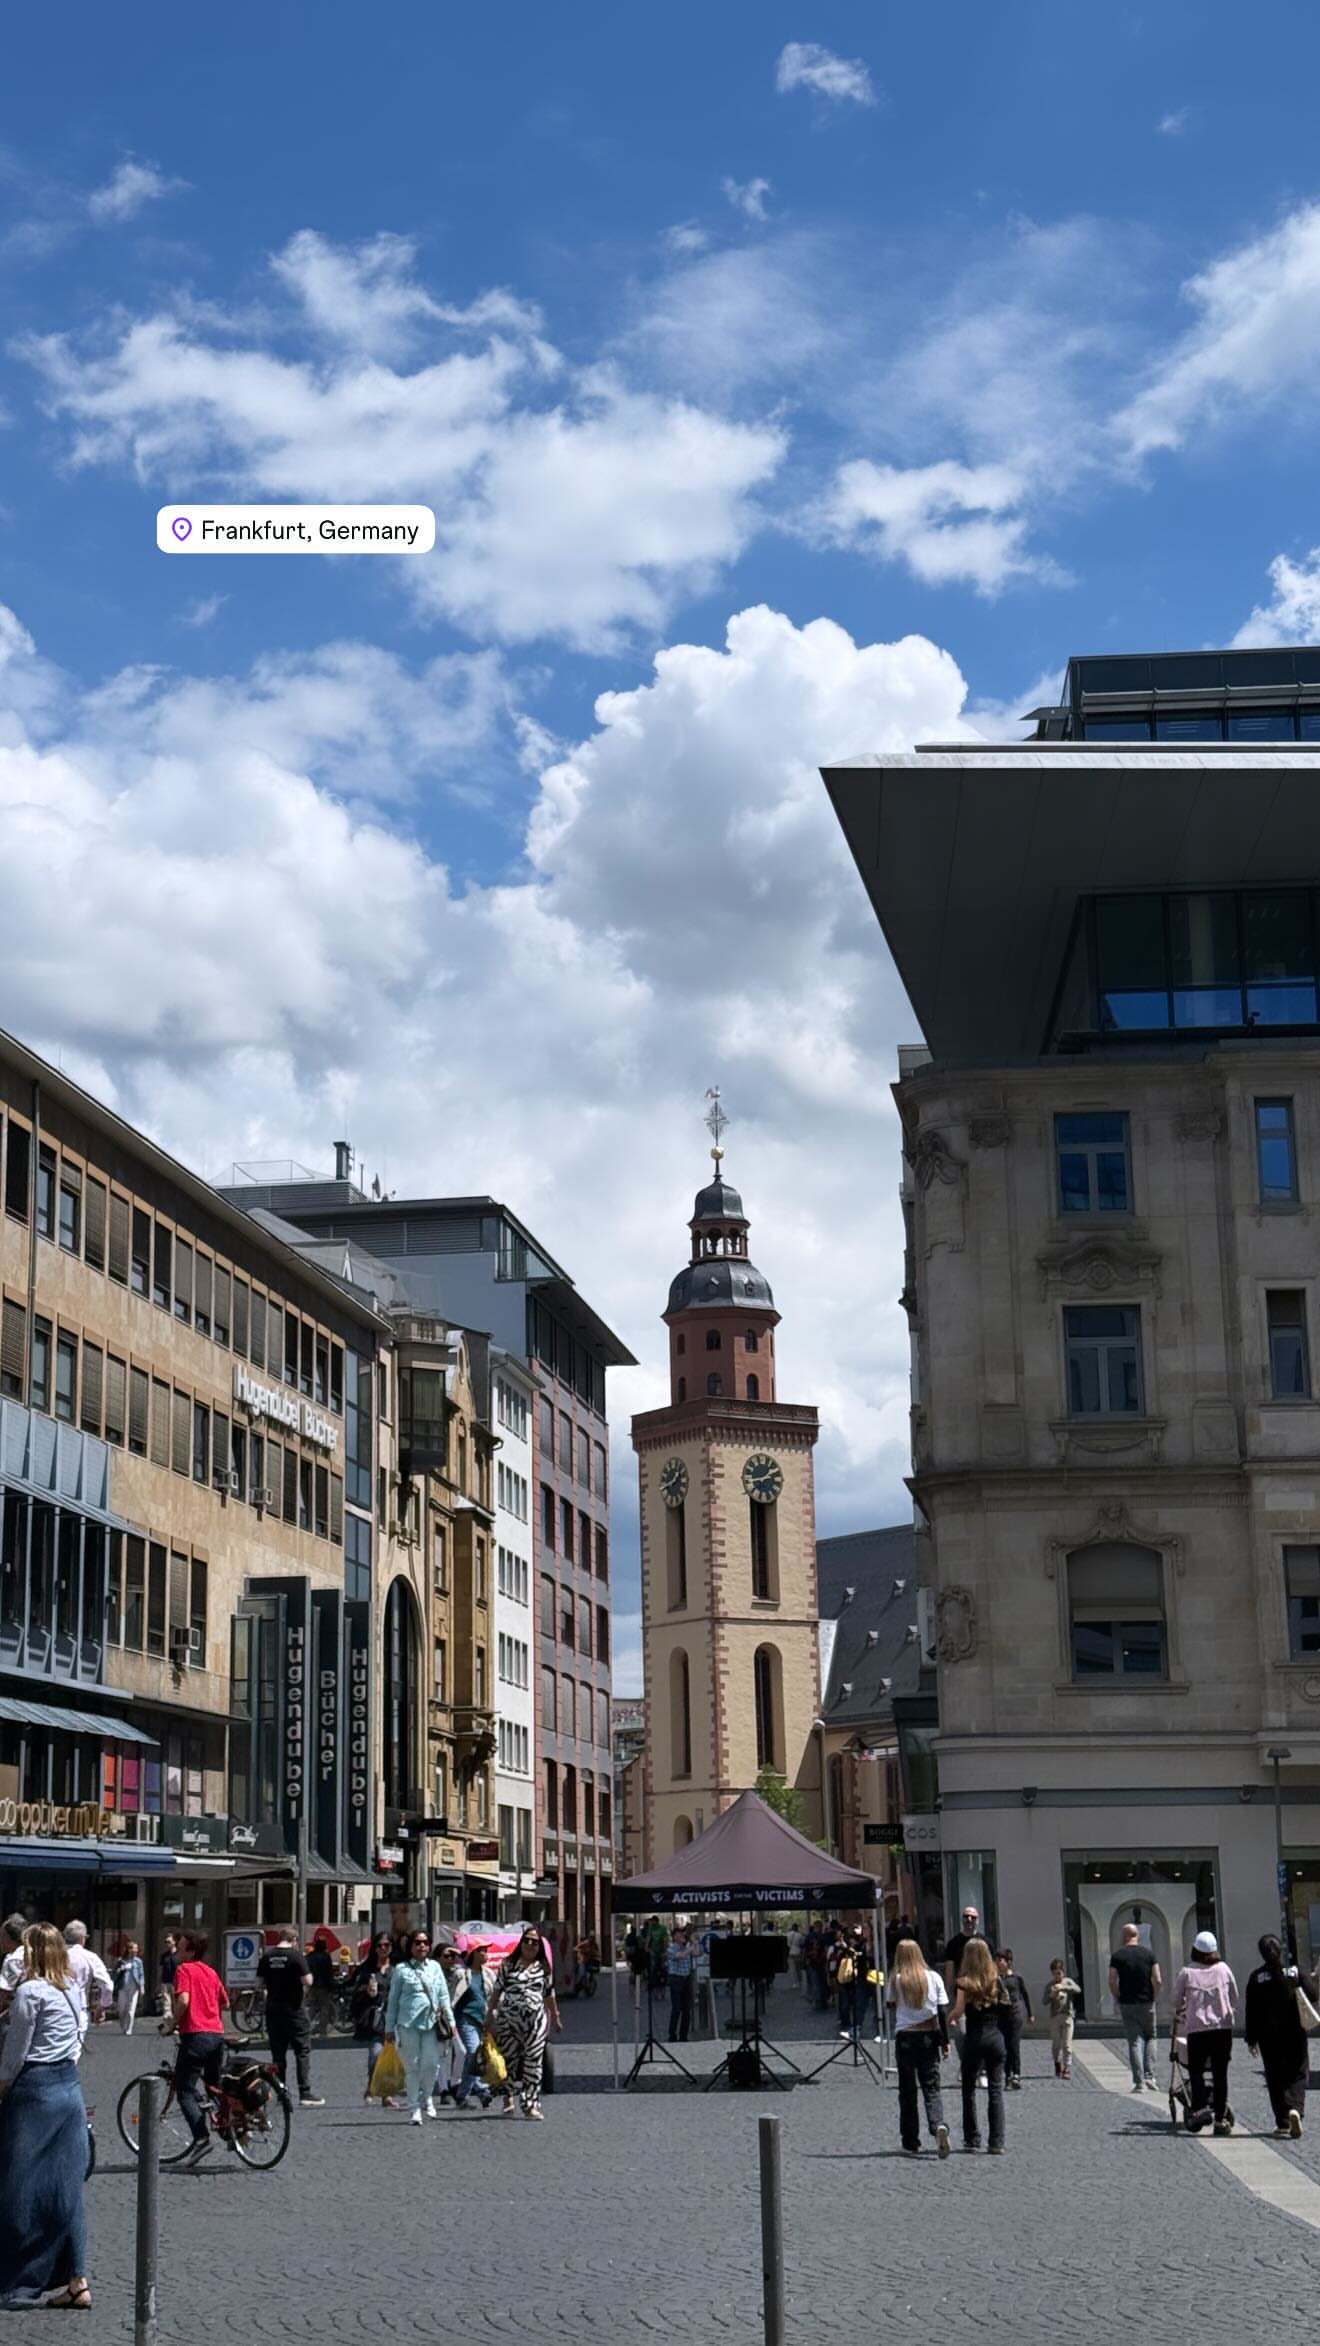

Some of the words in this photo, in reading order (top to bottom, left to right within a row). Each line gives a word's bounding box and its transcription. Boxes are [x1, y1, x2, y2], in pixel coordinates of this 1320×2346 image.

[236, 1363, 301, 1433] Hugendubel
[304, 1404, 338, 1450] Bücher
[286, 1626, 304, 1820] Hugendubel
[320, 1670, 337, 1781] Bücher
[351, 1648, 368, 1828] Hugendubel
[906, 1827, 937, 1840] COS
[672, 1890, 731, 1904] ACTIVISTS
[755, 1889, 805, 1902] VICTIMS
